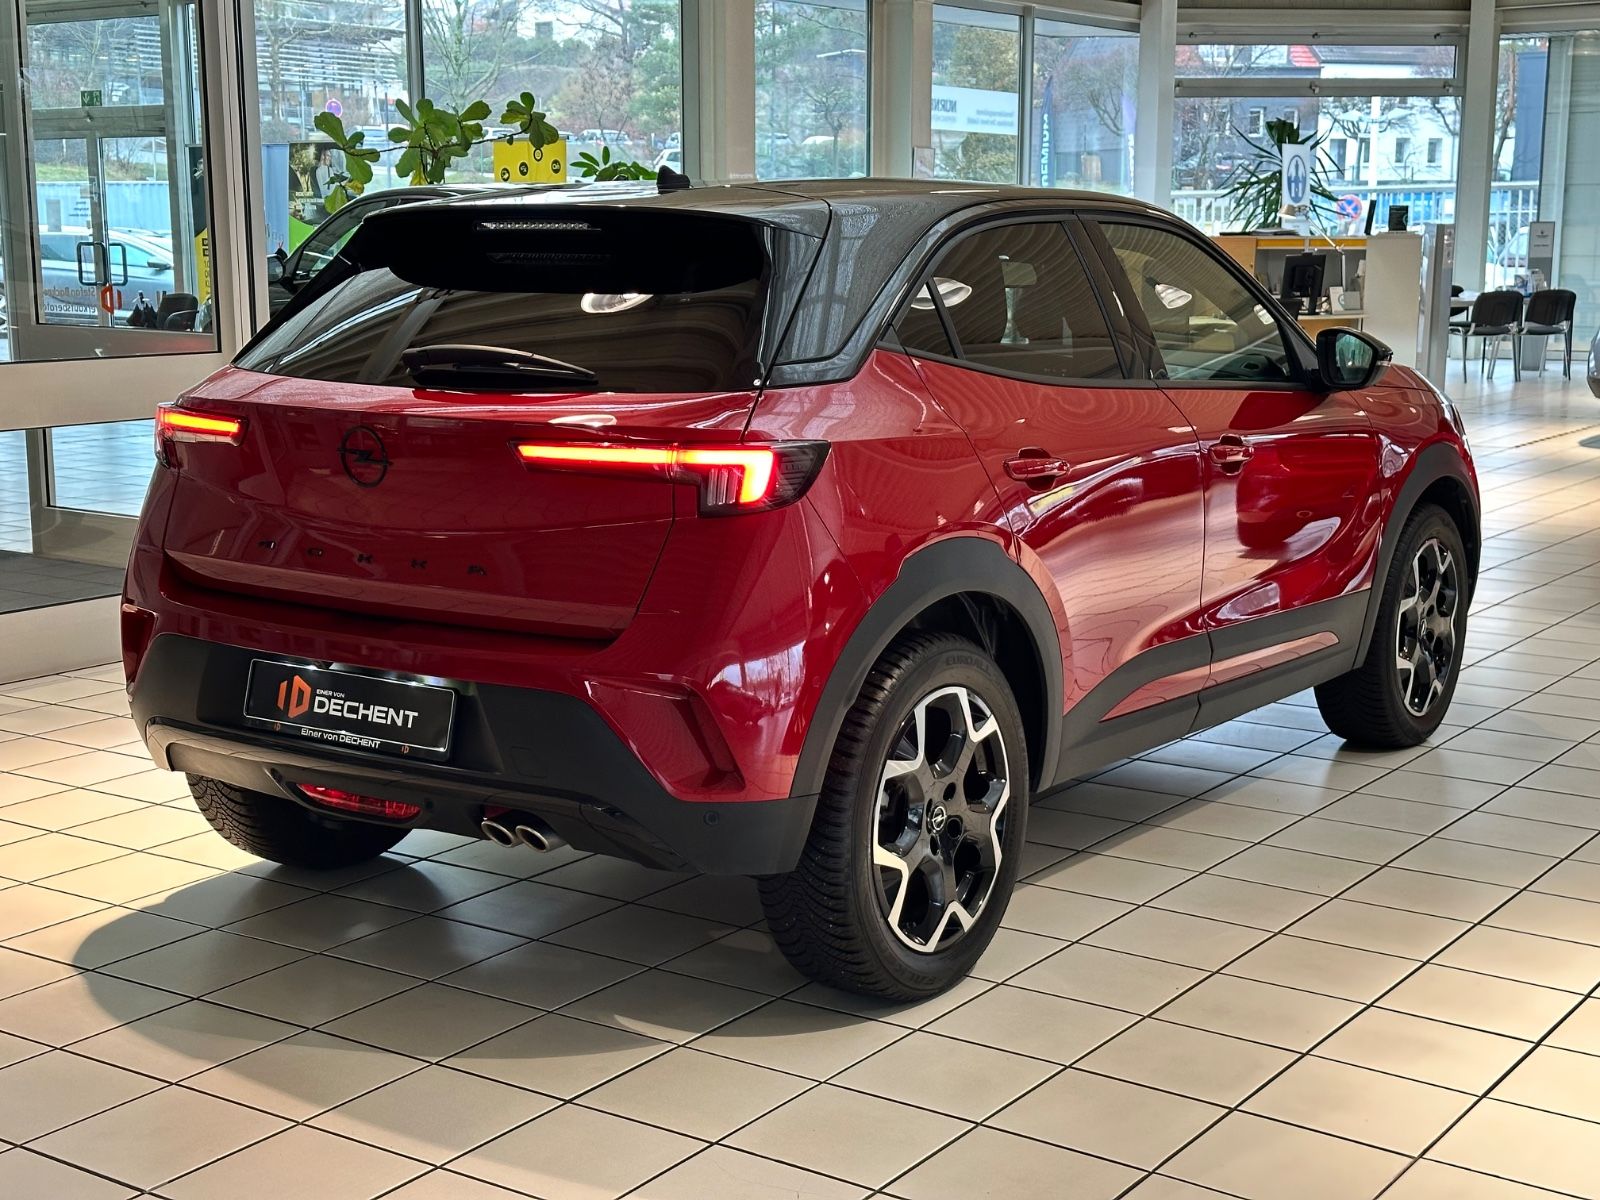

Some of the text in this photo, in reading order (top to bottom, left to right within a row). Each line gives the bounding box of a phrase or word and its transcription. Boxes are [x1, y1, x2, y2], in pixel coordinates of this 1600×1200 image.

[316, 688, 333, 697] EINER
[313, 695, 419, 729] DECHENT
[323, 732, 338, 742] von
[339, 734, 381, 749] DECHENT
